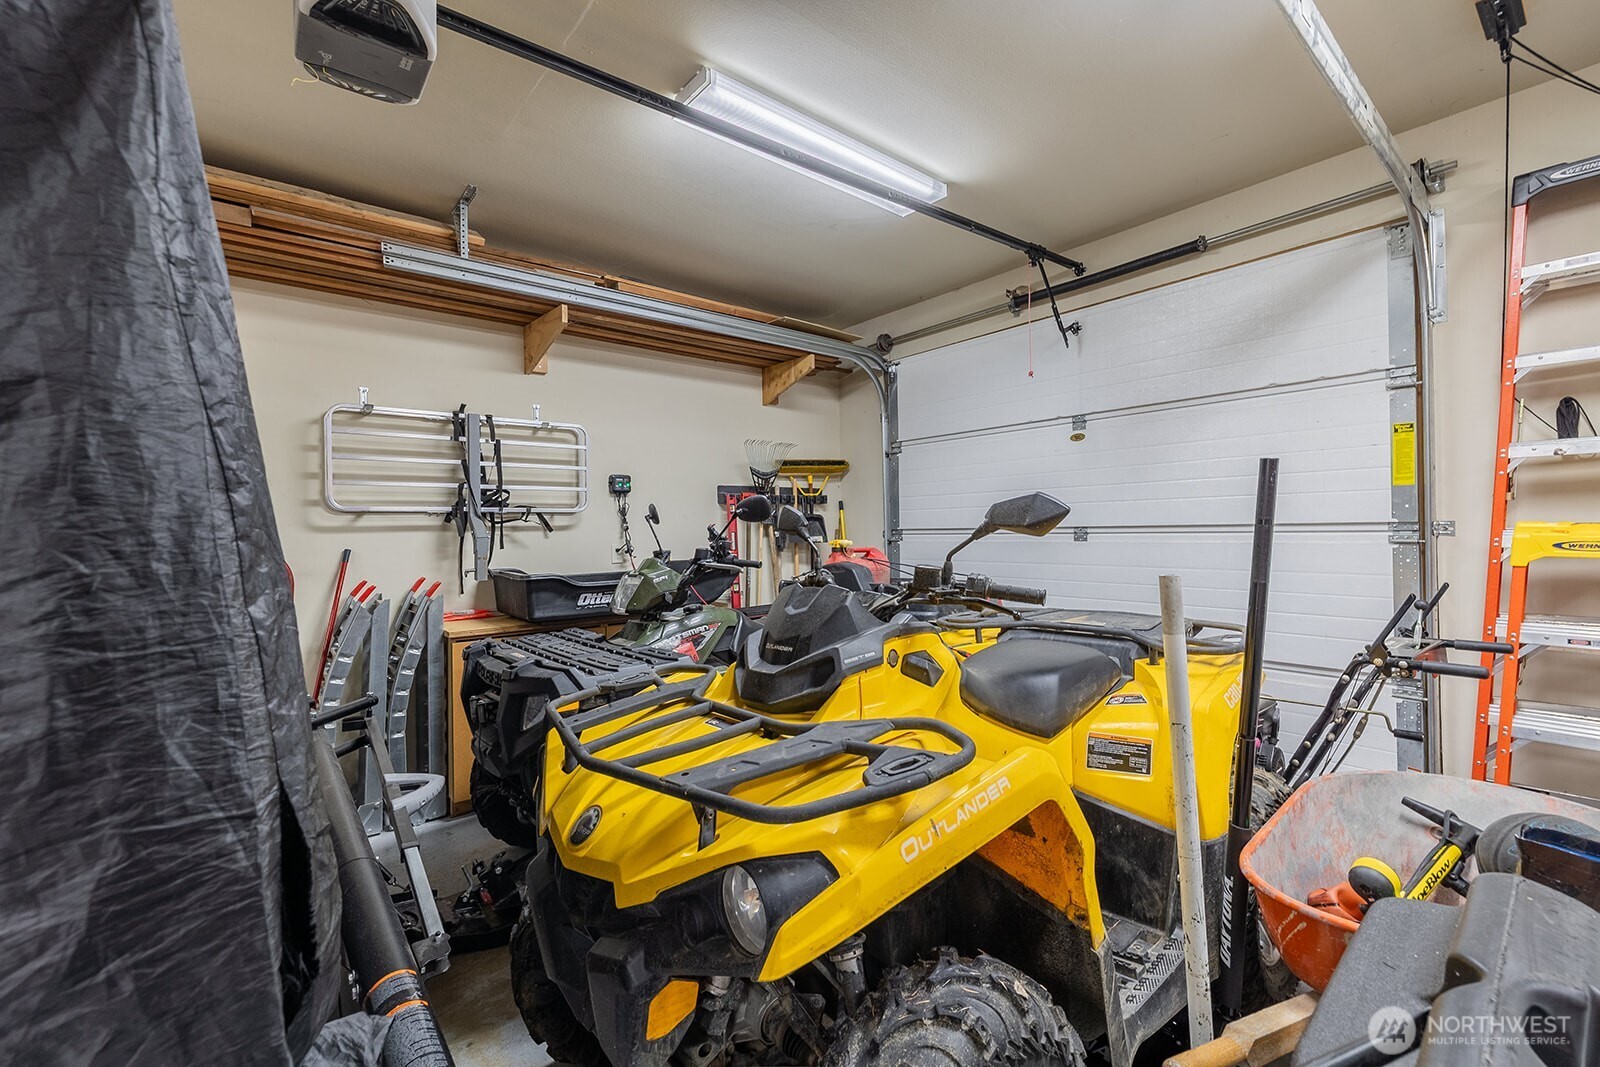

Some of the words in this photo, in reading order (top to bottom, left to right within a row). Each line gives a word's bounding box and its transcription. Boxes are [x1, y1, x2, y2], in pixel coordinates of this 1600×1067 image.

[1566, 160, 1600, 175] WERN
[900, 775, 1011, 864] OUTLANDER
[1412, 859, 1451, 901] oeBlow
[1220, 875, 1234, 969] DAYTONA
